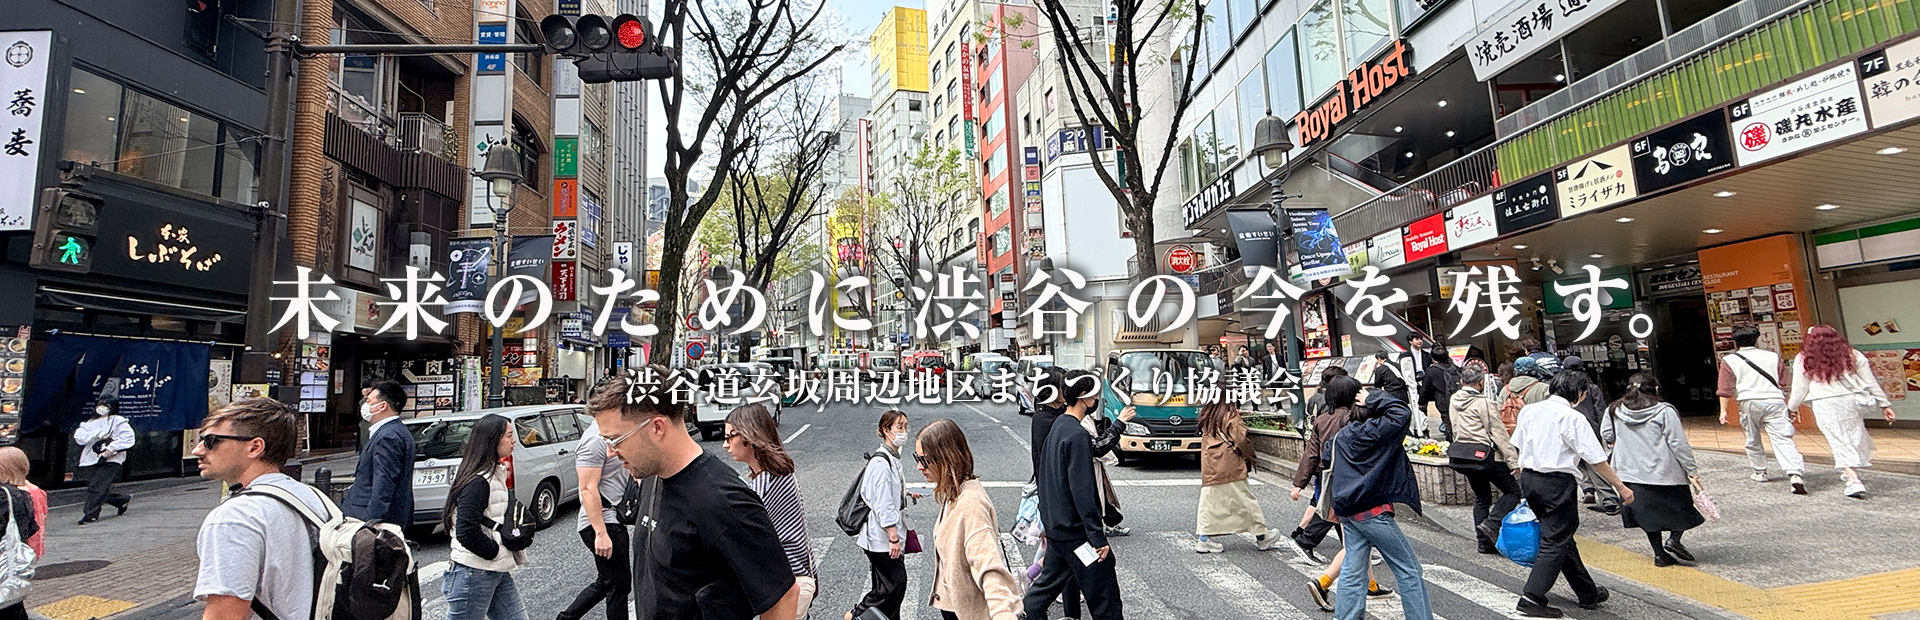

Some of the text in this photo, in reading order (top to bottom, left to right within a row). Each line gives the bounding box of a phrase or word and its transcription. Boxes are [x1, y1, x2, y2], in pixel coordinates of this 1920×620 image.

[1474, 3, 1553, 67] 焼売酒場
[961, 44, 970, 80] たかの友梨
[1863, 57, 1885, 73] 7F
[1294, 38, 1409, 147] Royal Host
[1732, 104, 1749, 118] 6F
[1774, 97, 1858, 137] 磯丸水産
[4, 88, 36, 157] 蕎麦
[1744, 125, 1768, 149] 磯
[1634, 140, 1648, 152] 6F
[1557, 170, 1568, 180] 5F
[1182, 174, 1231, 227] サンマルクカフェ
[1495, 191, 1504, 201] 4F
[1569, 182, 1626, 209] ミライザカ
[1445, 211, 1453, 219] 4F
[553, 222, 568, 257] ラーメン
[1403, 227, 1410, 235] 3F
[1411, 238, 1429, 252] Royal
[1429, 233, 1445, 246] Host
[128, 236, 221, 271] しぶそば
[1171, 256, 1190, 265] 消火栓
[1703, 270, 1739, 279] RESTAURANT
[425, 360, 443, 375] 肉
[421, 474, 446, 484] 79-97
